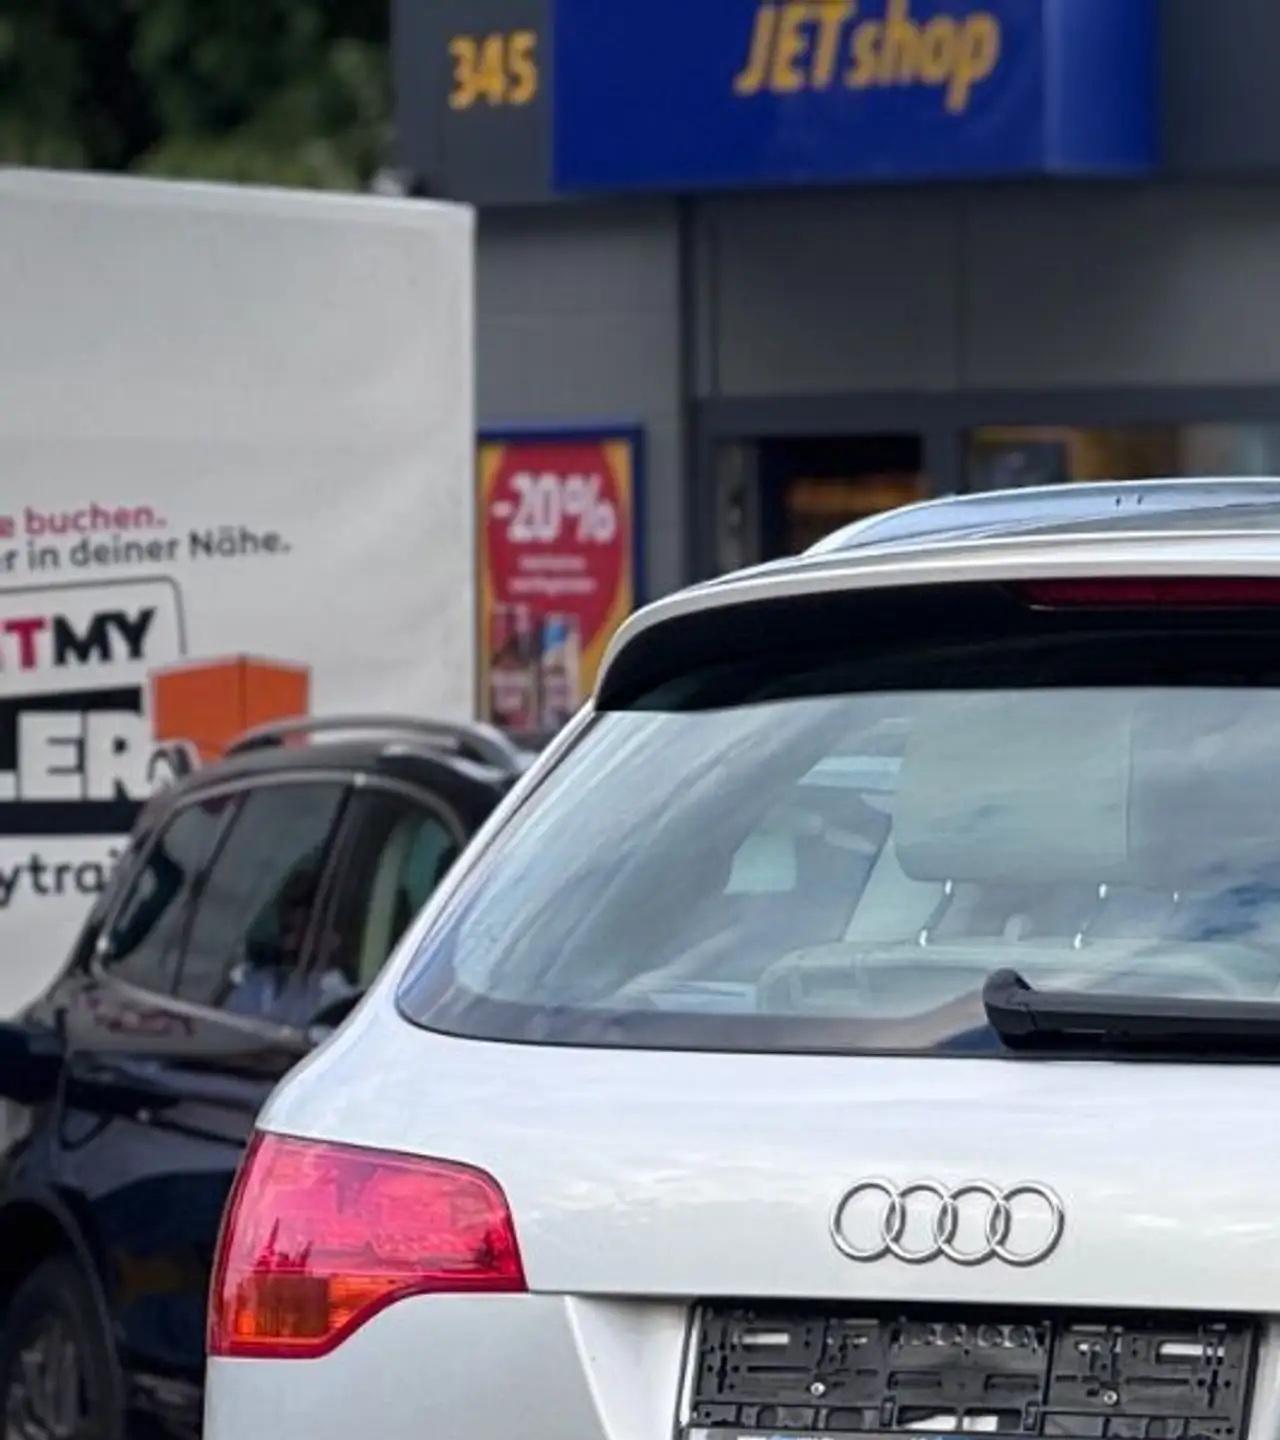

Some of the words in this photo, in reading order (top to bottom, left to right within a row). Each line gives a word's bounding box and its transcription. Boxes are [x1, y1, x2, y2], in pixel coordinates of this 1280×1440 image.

[449, 31, 537, 109] 345
[734, 0, 855, 96] JET
[844, 0, 1000, 115] shop
[24, 500, 168, 536] buchen.
[491, 471, 617, 545] -20%
[27, 538, 61, 571] in
[69, 533, 181, 568] deiner
[188, 525, 293, 560] Nähe.
[0, 606, 157, 672] TMY
